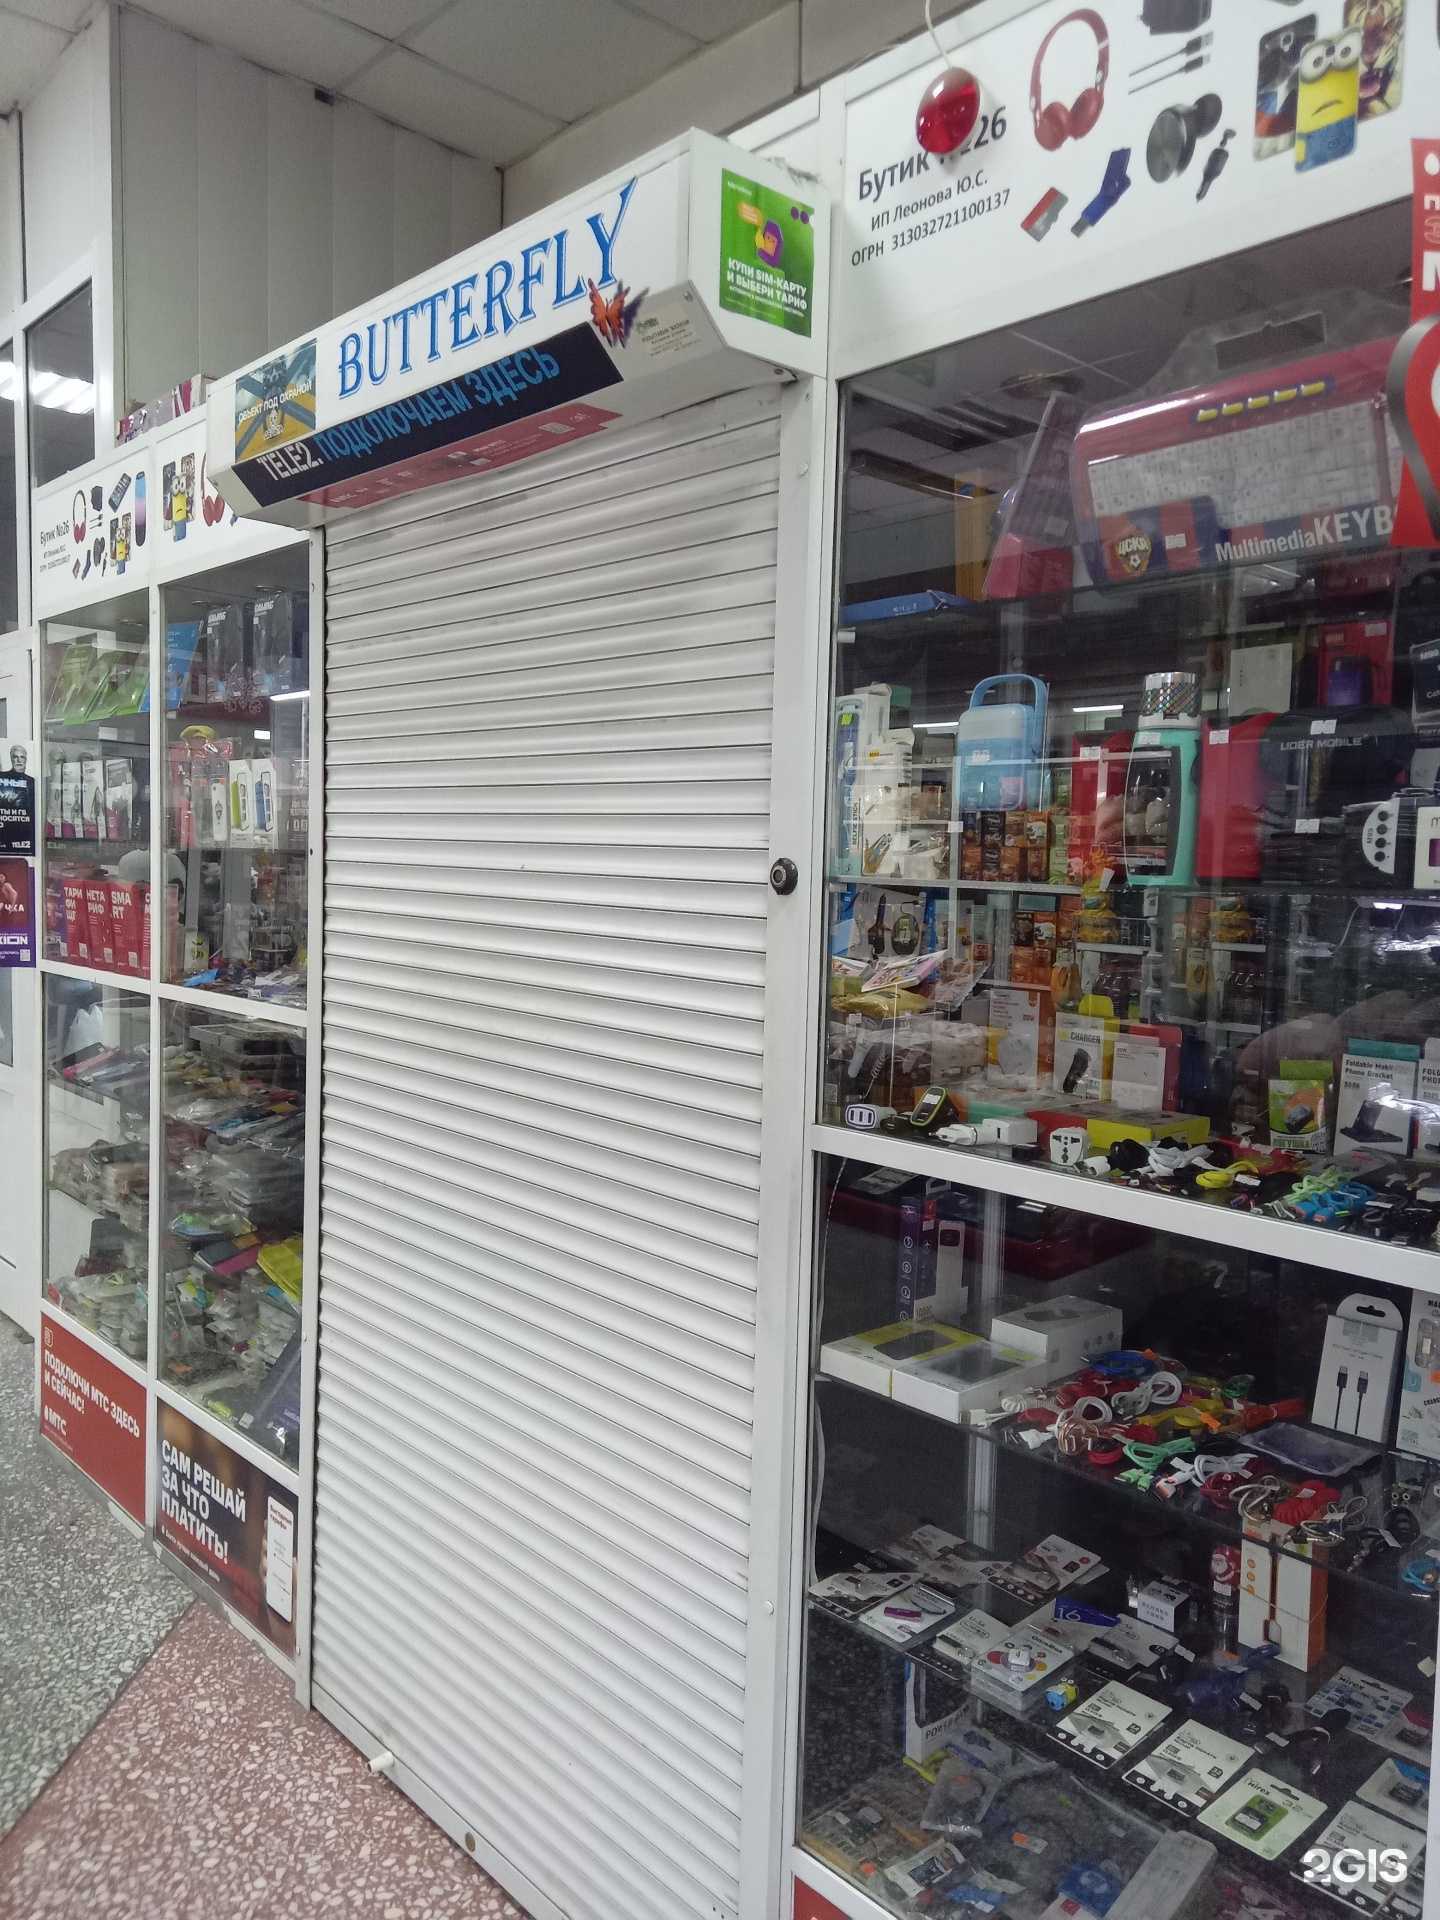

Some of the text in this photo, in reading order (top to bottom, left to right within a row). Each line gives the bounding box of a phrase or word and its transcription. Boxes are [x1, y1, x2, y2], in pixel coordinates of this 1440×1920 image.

[858, 106, 1007, 203] Бутик 26
[851, 188, 1011, 267] ОГРН 313032721100137
[871, 169, 988, 232] ИП Леонова Ю.С.
[338, 175, 639, 401] BUTTERFLY
[726, 270, 735, 284] И
[736, 275, 774, 299] ВЫБЕРИ
[775, 289, 808, 310] ТАРИФ
[728, 257, 807, 297] КУПИ SIM-КАРТУ
[237, 379, 313, 424] ОБЪЕКТ ПОД ОХРАНОЙ
[313, 381, 473, 462] ПОДКЛЮЧАЕМ
[465, 345, 561, 408] ЗДЕСЬ
[111, 891, 132, 906] SMA
[112, 905, 125, 919] RT
[44, 1370, 85, 1415] И СЕЙЧАС!
[44, 1349, 90, 1398] ПОДКЛЮЧИ
[91, 1385, 109, 1413] МТС
[110, 1401, 140, 1438] ЗДЕСЬ
[48, 1407, 67, 1437] МТС
[161, 1439, 191, 1480] САМ
[193, 1462, 246, 1523] РЕШАЙ
[161, 1465, 210, 1520] ЗА ЧТО
[161, 1490, 228, 1565] ПЛАТИТЬ!
[1058, 1607, 1081, 1620] 16
